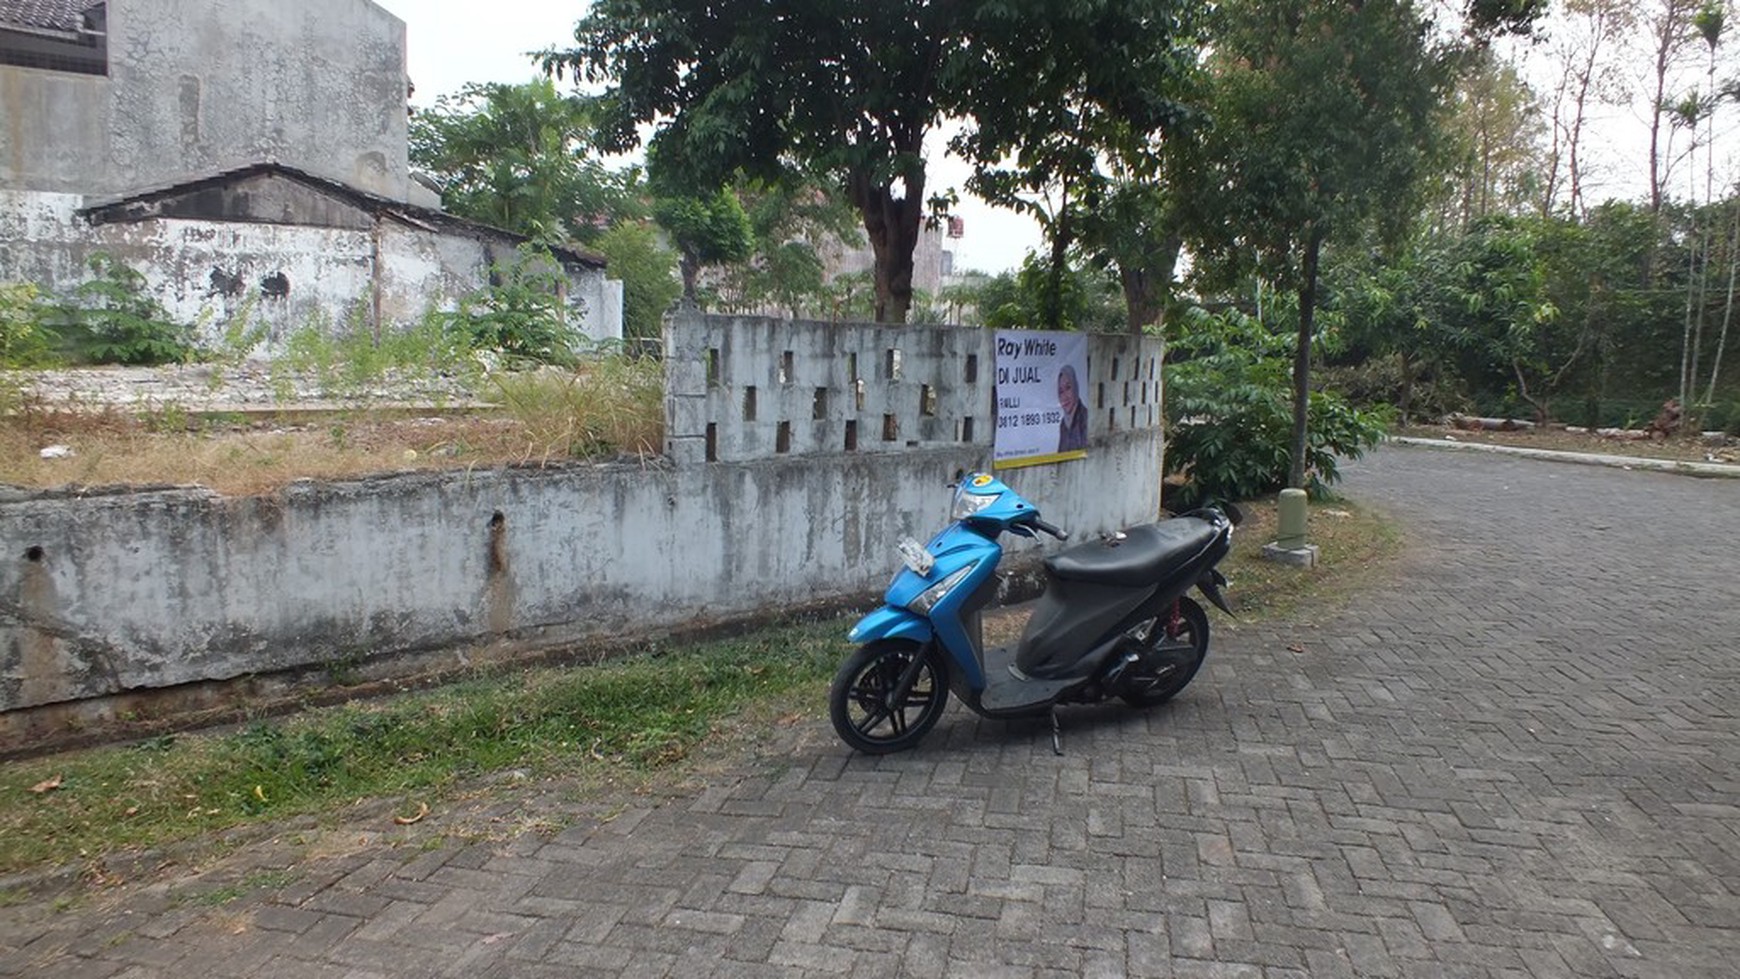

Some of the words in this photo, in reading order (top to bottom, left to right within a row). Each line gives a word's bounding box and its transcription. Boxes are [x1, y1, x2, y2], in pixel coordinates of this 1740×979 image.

[998, 338, 1022, 359] Ray
[1024, 338, 1057, 356] White
[999, 367, 1009, 384] DI
[1012, 367, 1041, 384] JUAL
